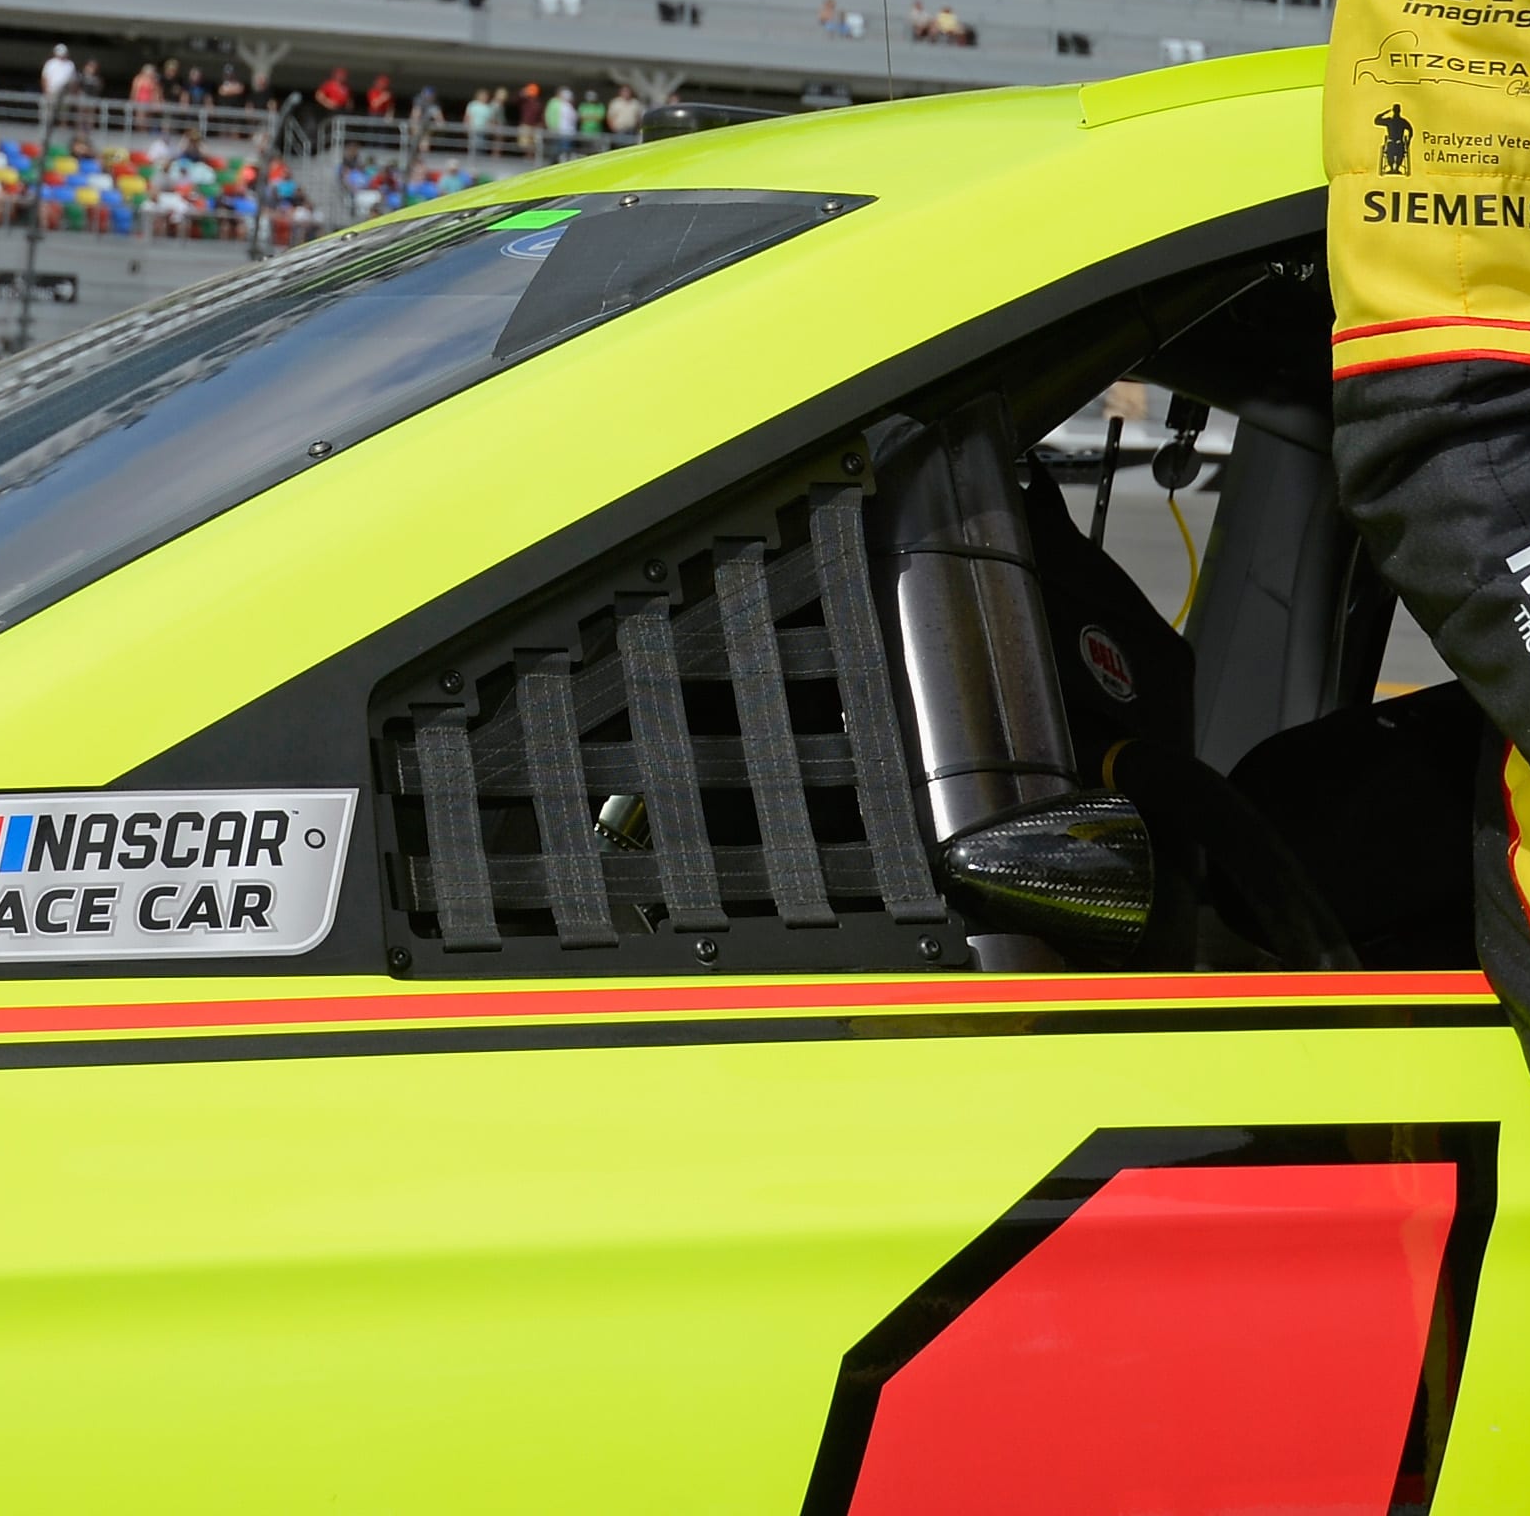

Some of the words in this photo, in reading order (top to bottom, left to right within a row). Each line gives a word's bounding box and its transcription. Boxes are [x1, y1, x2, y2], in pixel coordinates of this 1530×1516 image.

[1422, 131, 1493, 149] Paralyzed
[1423, 149, 1435, 162] of
[1436, 150, 1500, 165] America
[28, 809, 291, 873] NASCAR
[137, 883, 273, 934] CAR
